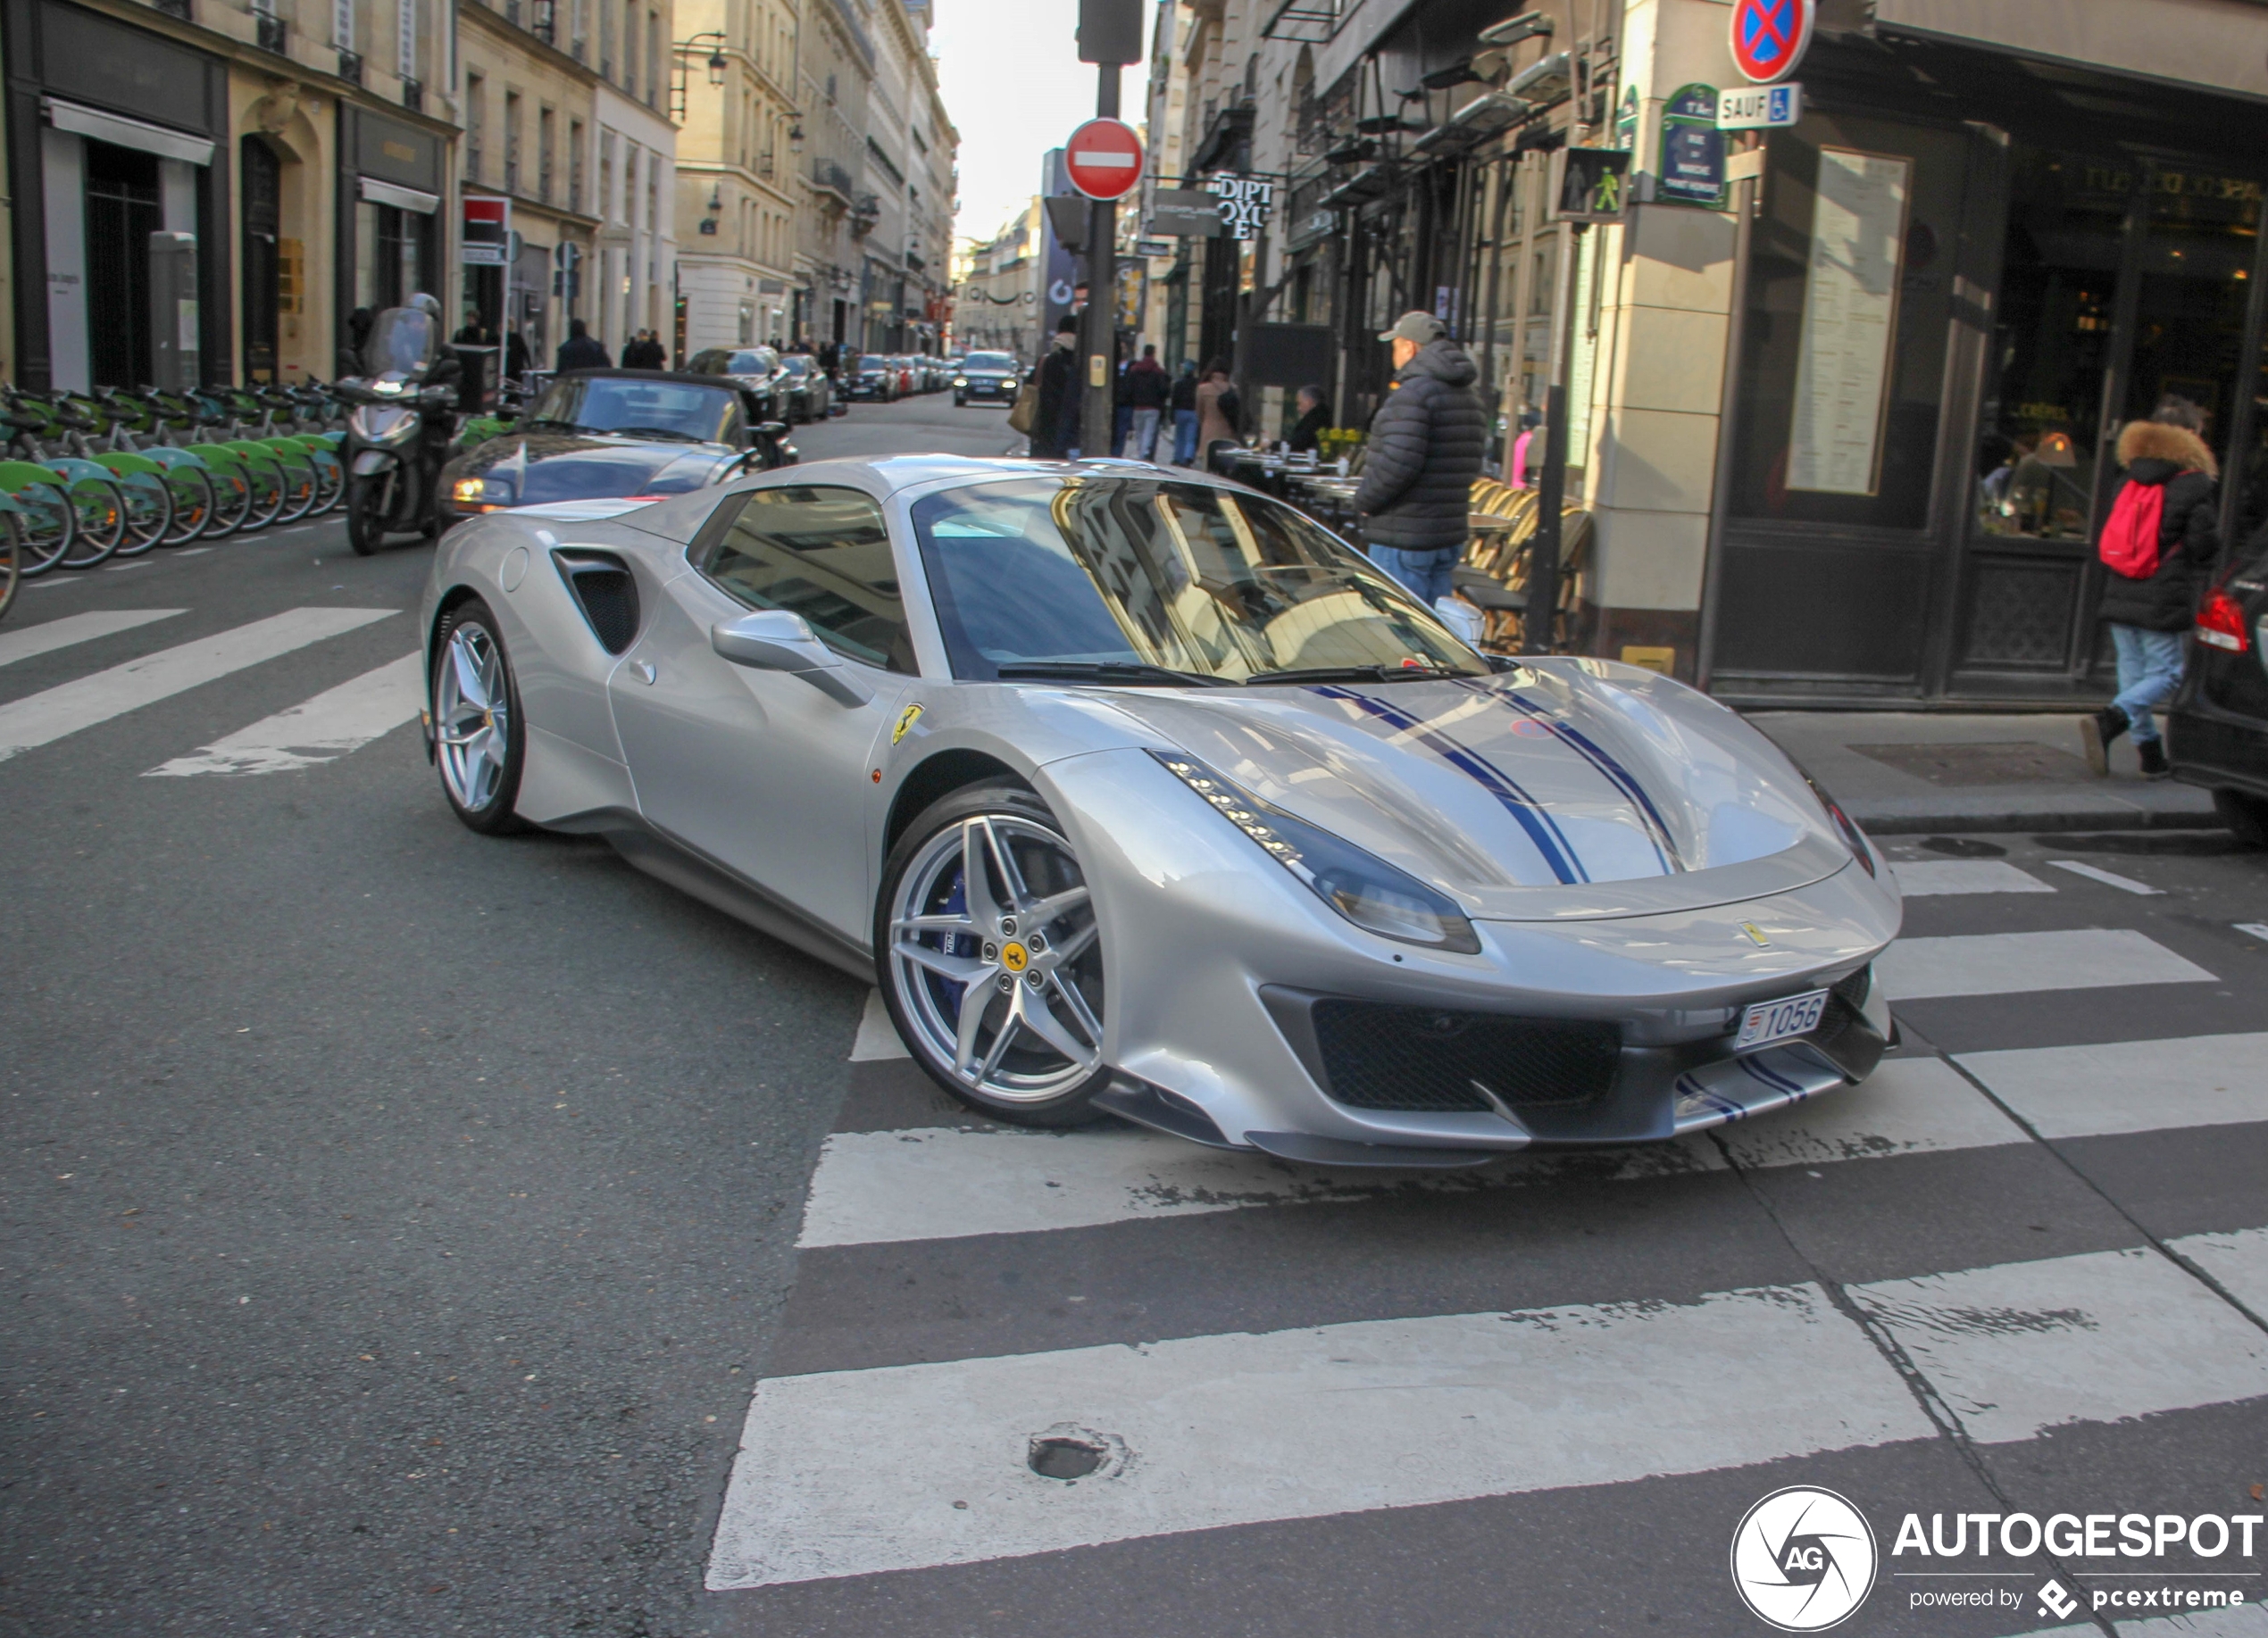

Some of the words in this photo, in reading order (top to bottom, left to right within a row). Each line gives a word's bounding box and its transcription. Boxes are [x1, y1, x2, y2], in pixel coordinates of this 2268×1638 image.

[1723, 95, 1767, 120] SAUF
[1218, 178, 1273, 204] DIPT
[1232, 220, 1252, 240] E
[1764, 997, 1822, 1037] 1056
